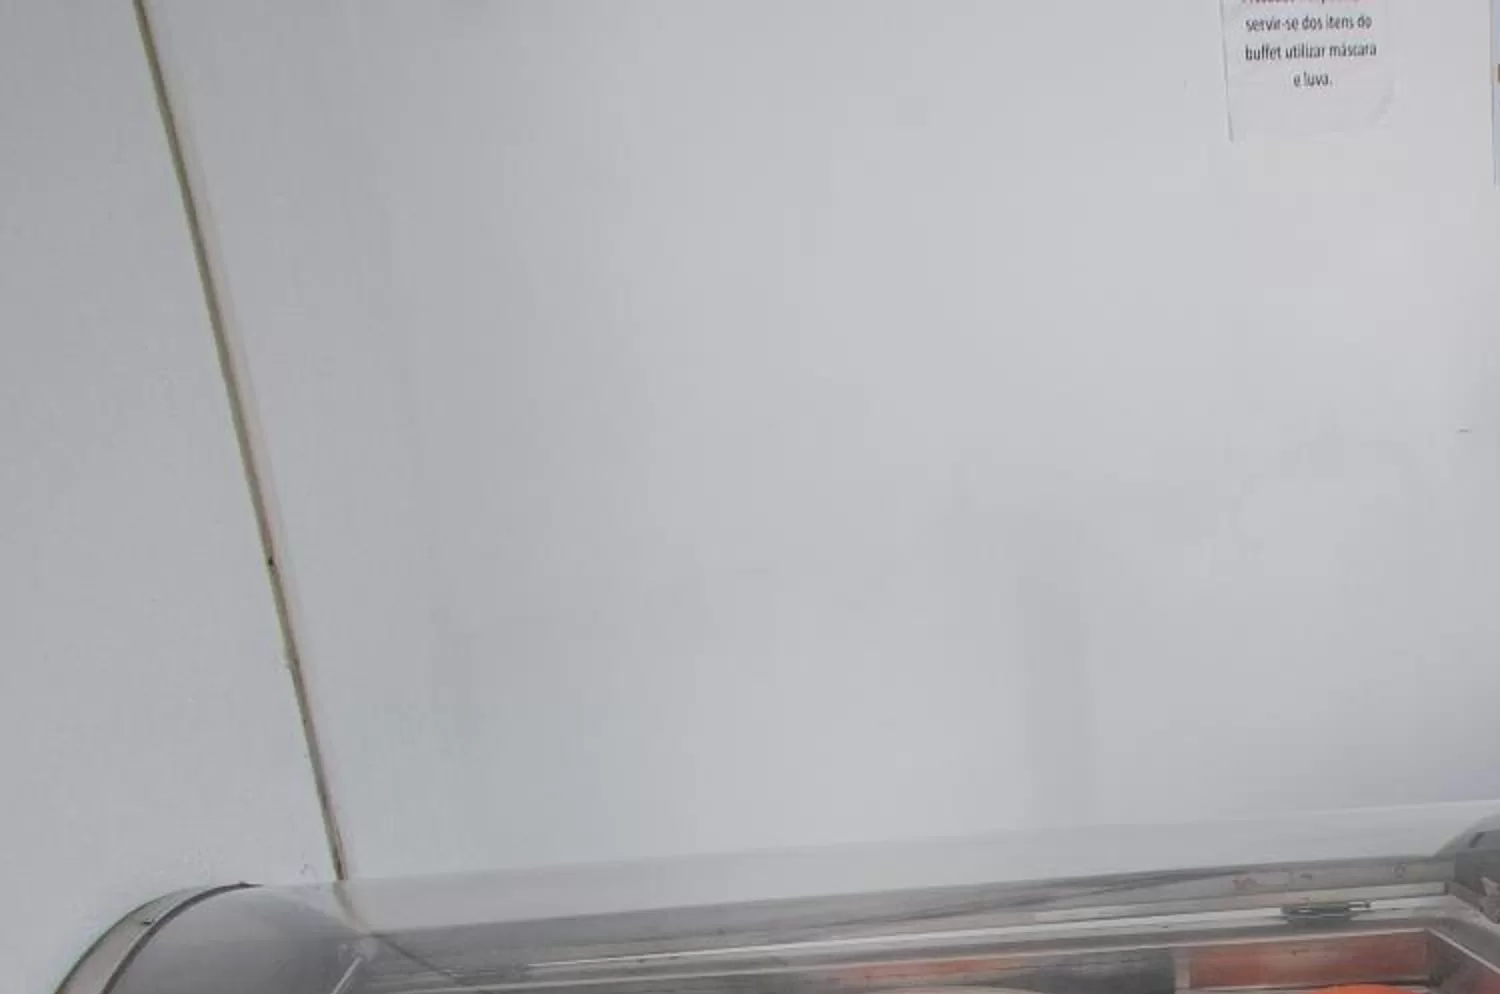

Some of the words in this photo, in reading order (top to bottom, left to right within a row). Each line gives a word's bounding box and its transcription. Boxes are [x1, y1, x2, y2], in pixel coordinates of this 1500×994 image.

[1245, 17, 1299, 31] servir-se
[1301, 15, 1323, 31] dos
[1325, 13, 1355, 30] itens
[1357, 13, 1373, 29] do
[1245, 44, 1282, 61] buffet
[1285, 43, 1325, 59] utilizar
[1328, 43, 1377, 57] máscara
[1293, 75, 1300, 87] e
[1303, 71, 1333, 87] luva.
